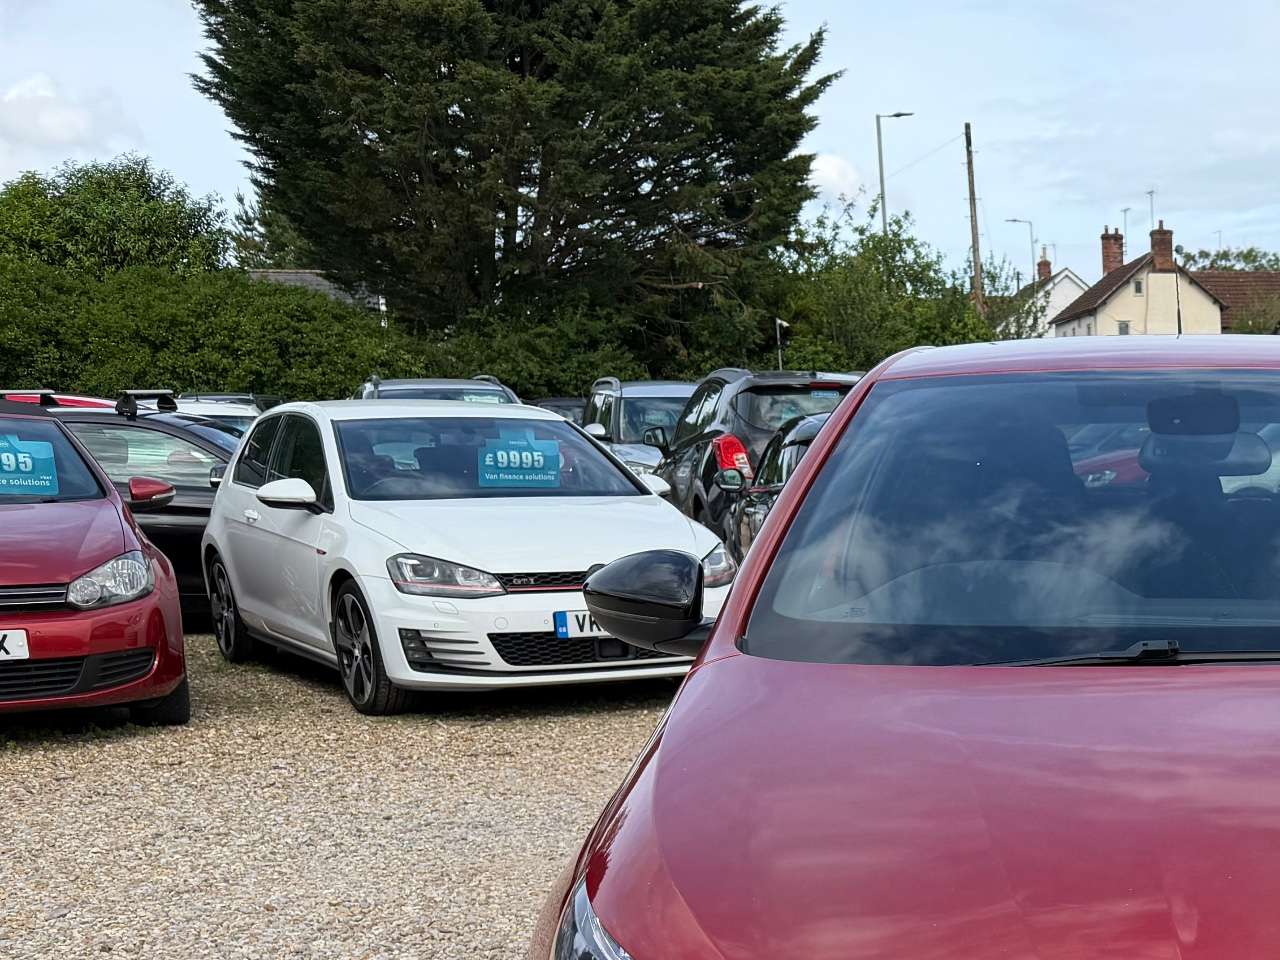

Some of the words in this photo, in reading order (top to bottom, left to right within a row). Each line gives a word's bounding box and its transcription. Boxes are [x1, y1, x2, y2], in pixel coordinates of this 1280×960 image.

[485, 472, 498, 480] Van
[525, 472, 555, 481] solutions
[9, 478, 50, 486] solutions
